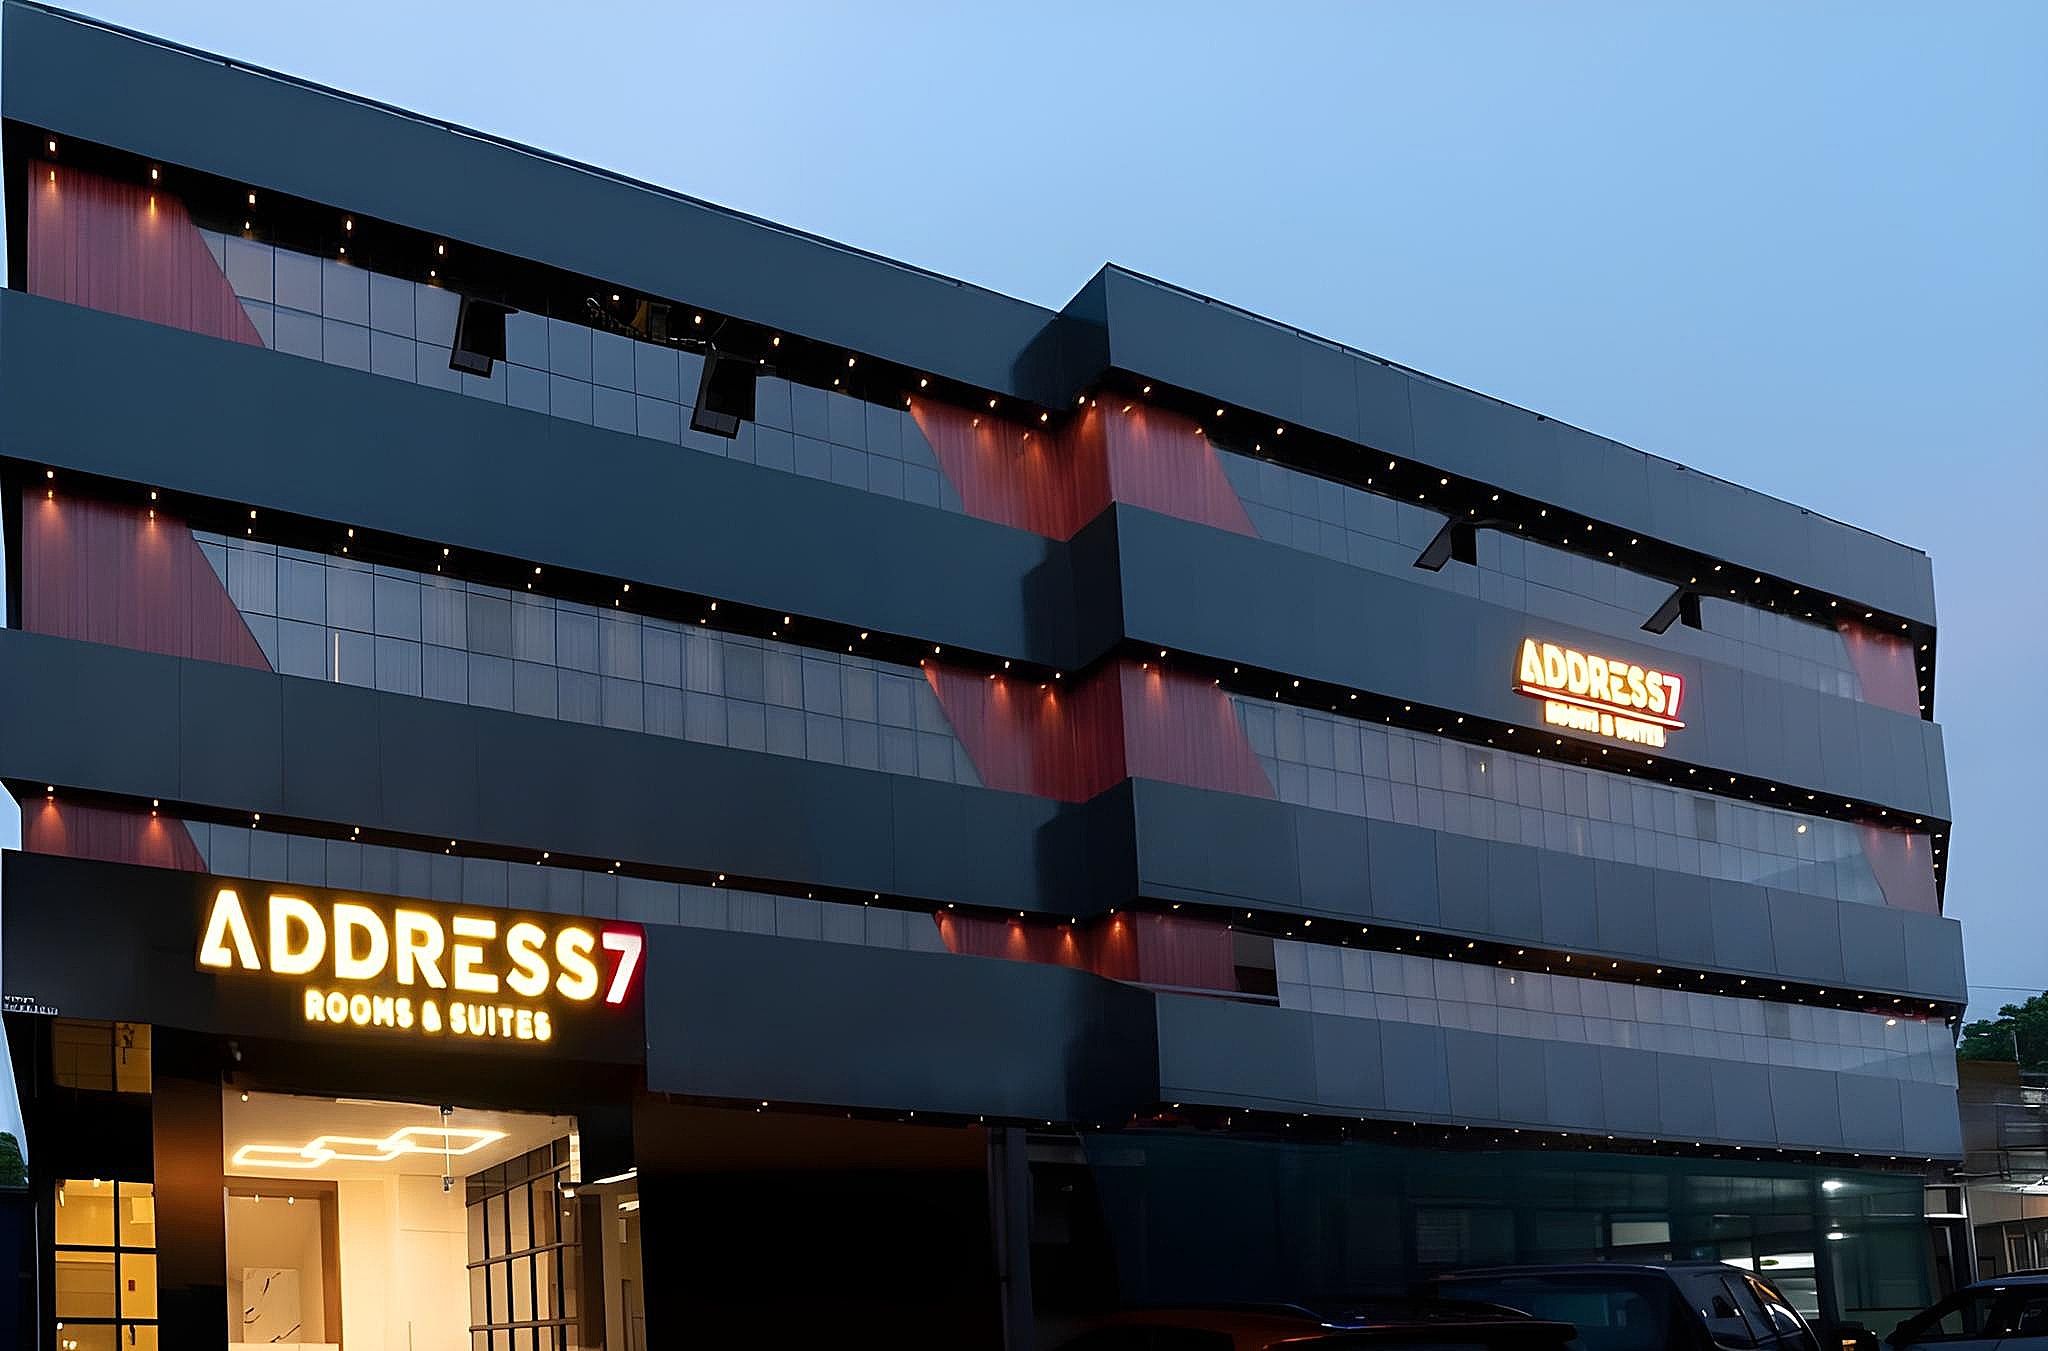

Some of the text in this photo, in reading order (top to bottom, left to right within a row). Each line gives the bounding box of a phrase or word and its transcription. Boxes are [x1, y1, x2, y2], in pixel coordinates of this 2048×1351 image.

[1520, 638, 1682, 717] ADDRESS7
[199, 889, 643, 1004] ADDRESS7
[304, 989, 552, 1041] ROOMS & SUITES
